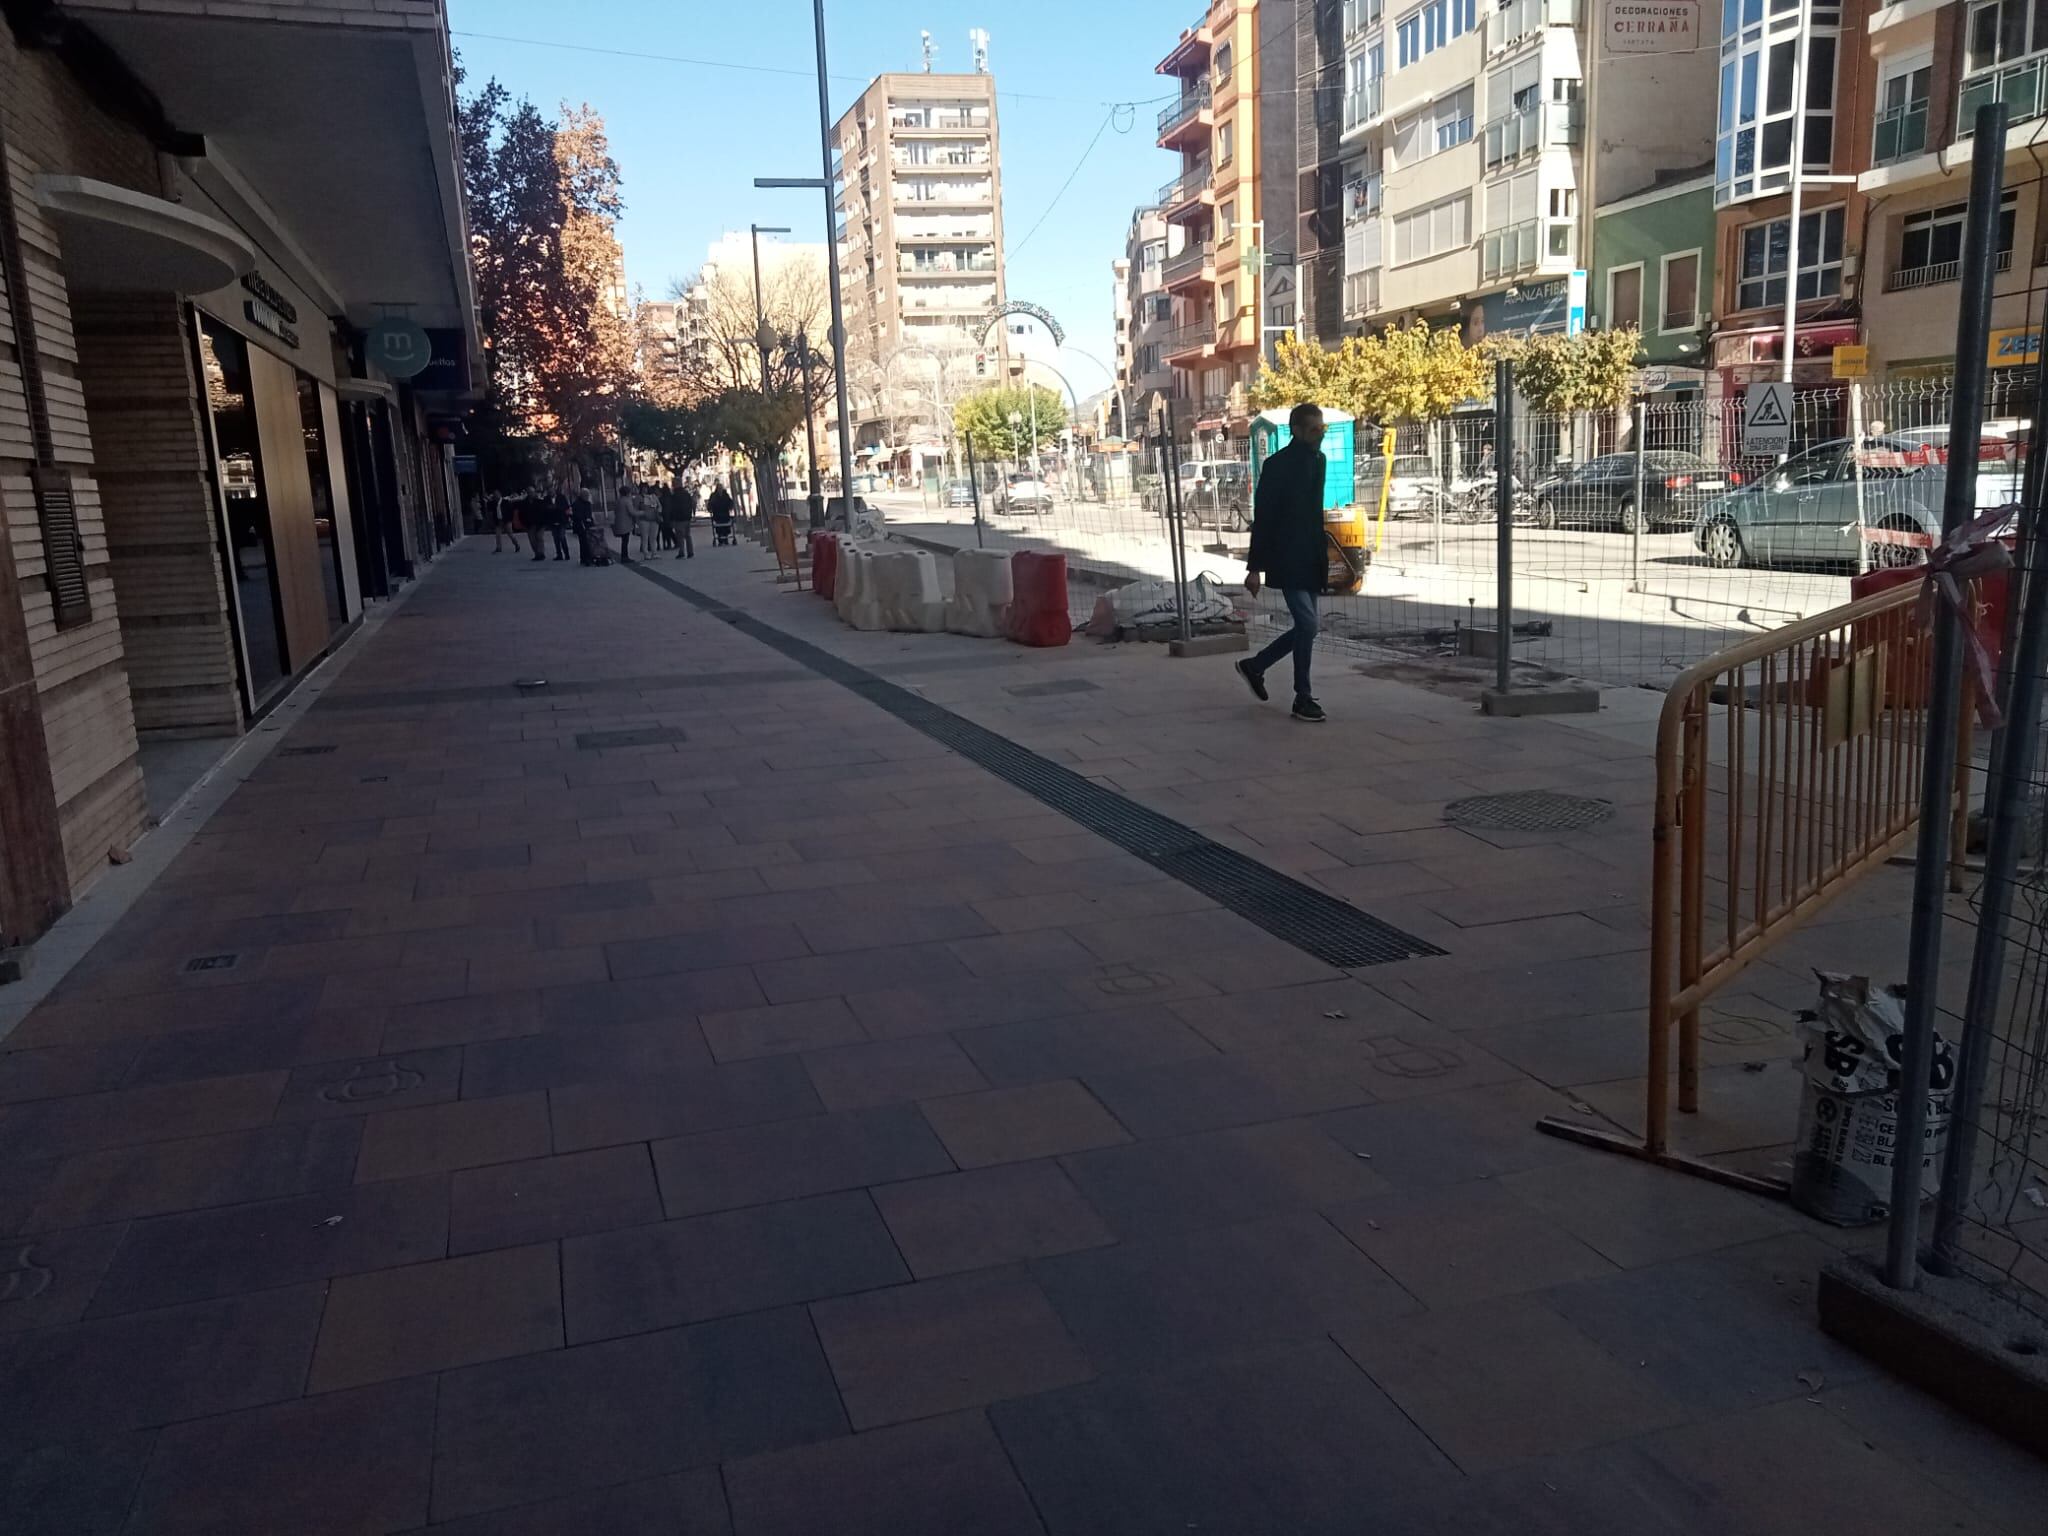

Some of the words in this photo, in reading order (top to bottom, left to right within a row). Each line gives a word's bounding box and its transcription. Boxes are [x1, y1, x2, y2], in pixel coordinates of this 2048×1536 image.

[1615, 6, 1689, 17] DECORACIONES
[1614, 17, 1690, 33] CERRAÑA
[1998, 334, 2041, 356] ZEE
